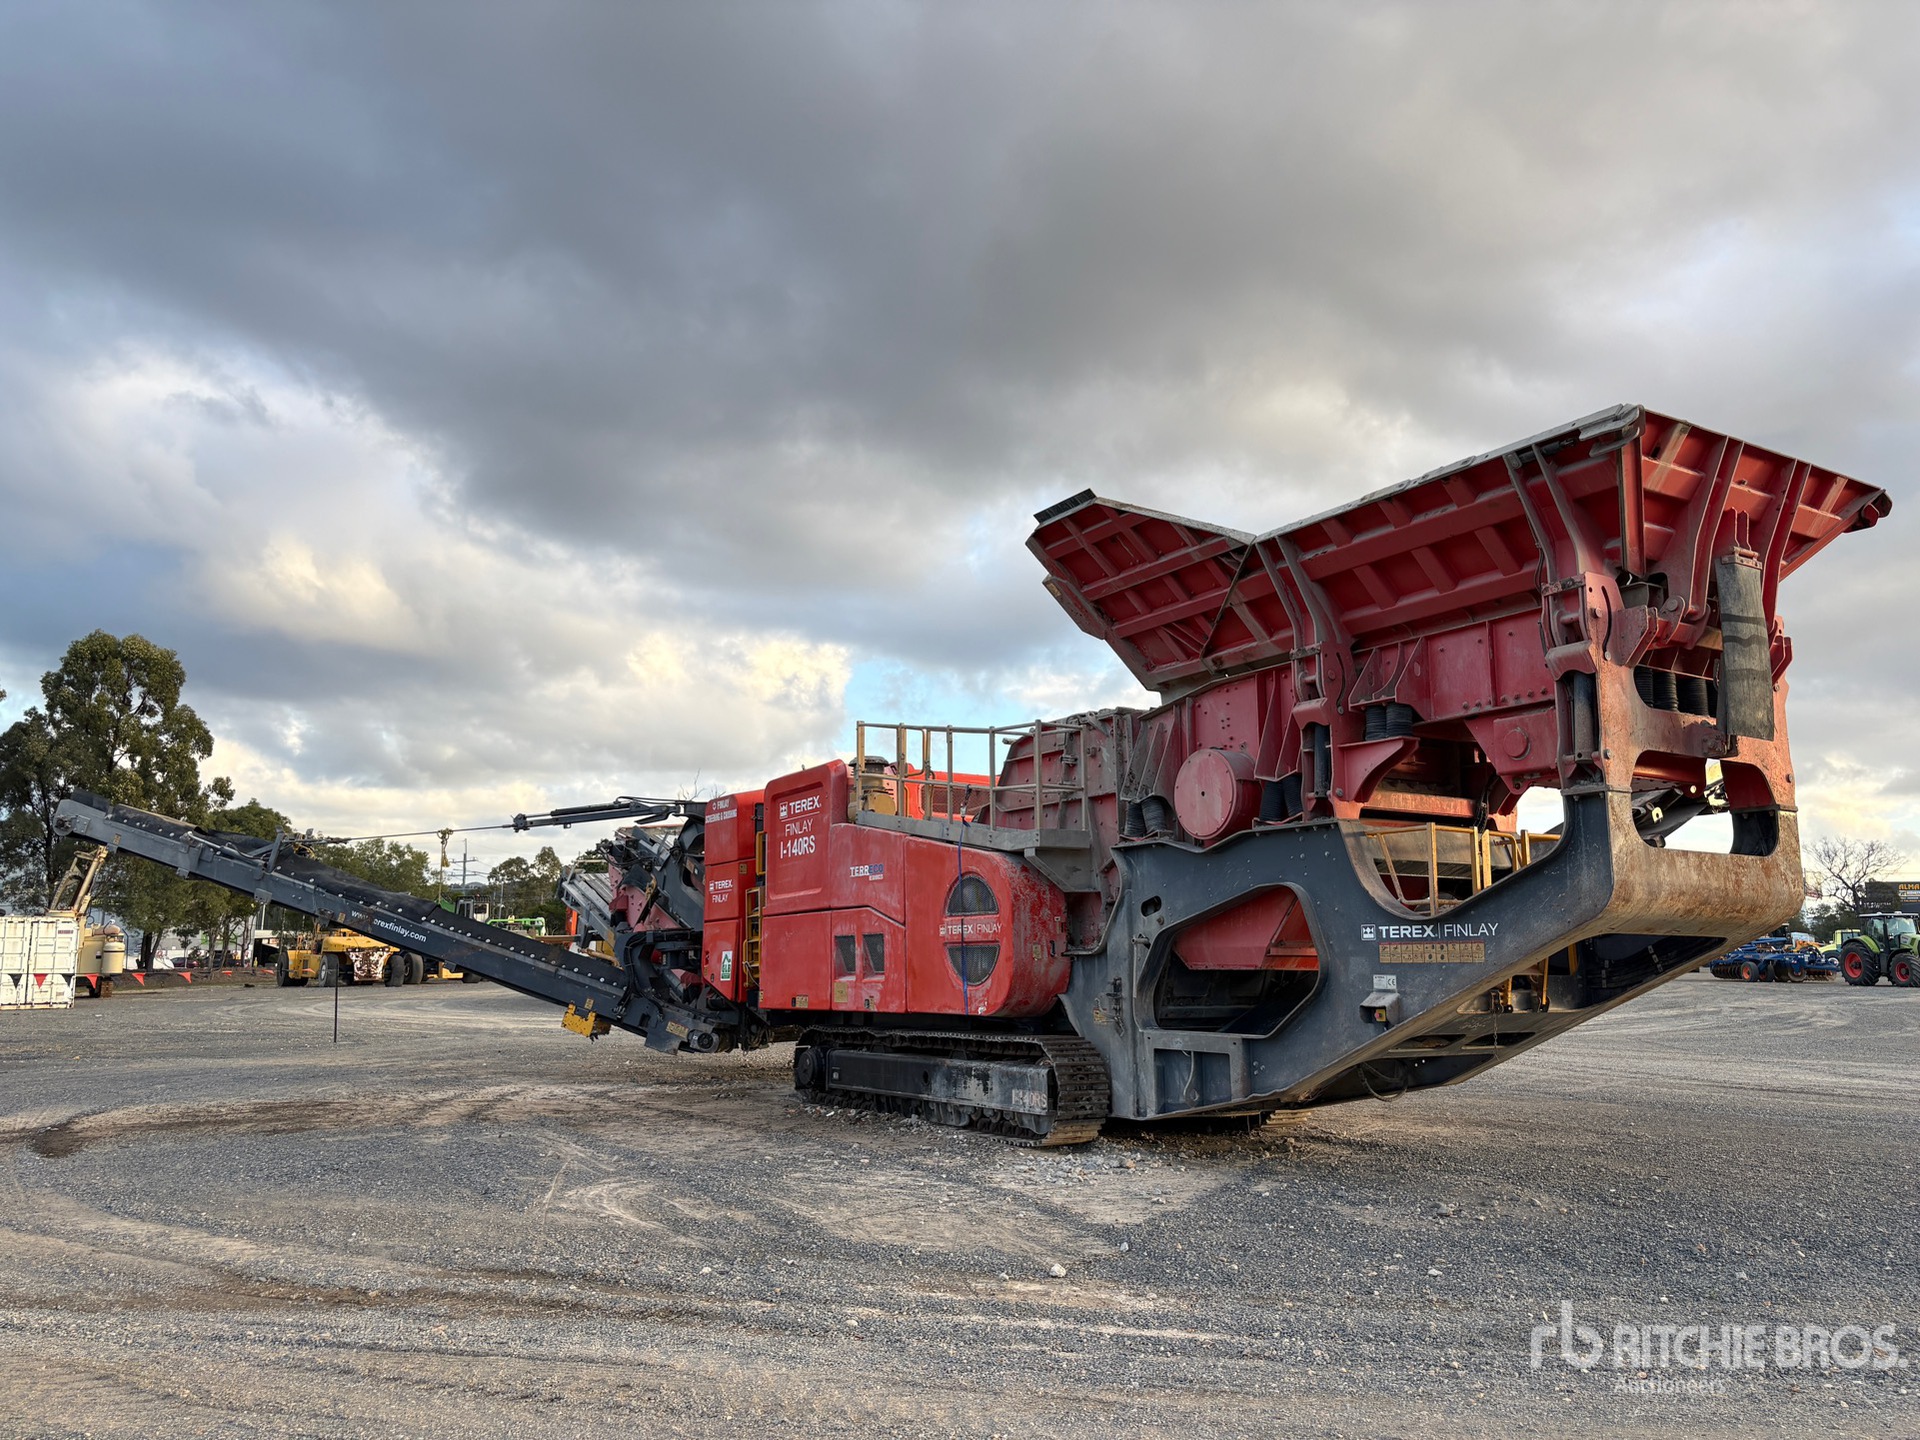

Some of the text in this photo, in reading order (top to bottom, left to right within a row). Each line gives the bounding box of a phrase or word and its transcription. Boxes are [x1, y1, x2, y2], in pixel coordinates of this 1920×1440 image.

[789, 795, 821, 814] TEREX
[785, 818, 813, 837] FINLAY
[780, 835, 816, 859] I-140RS
[976, 922, 1003, 934] FINLAY
[1379, 923, 1498, 938] TEREX FINLAY
